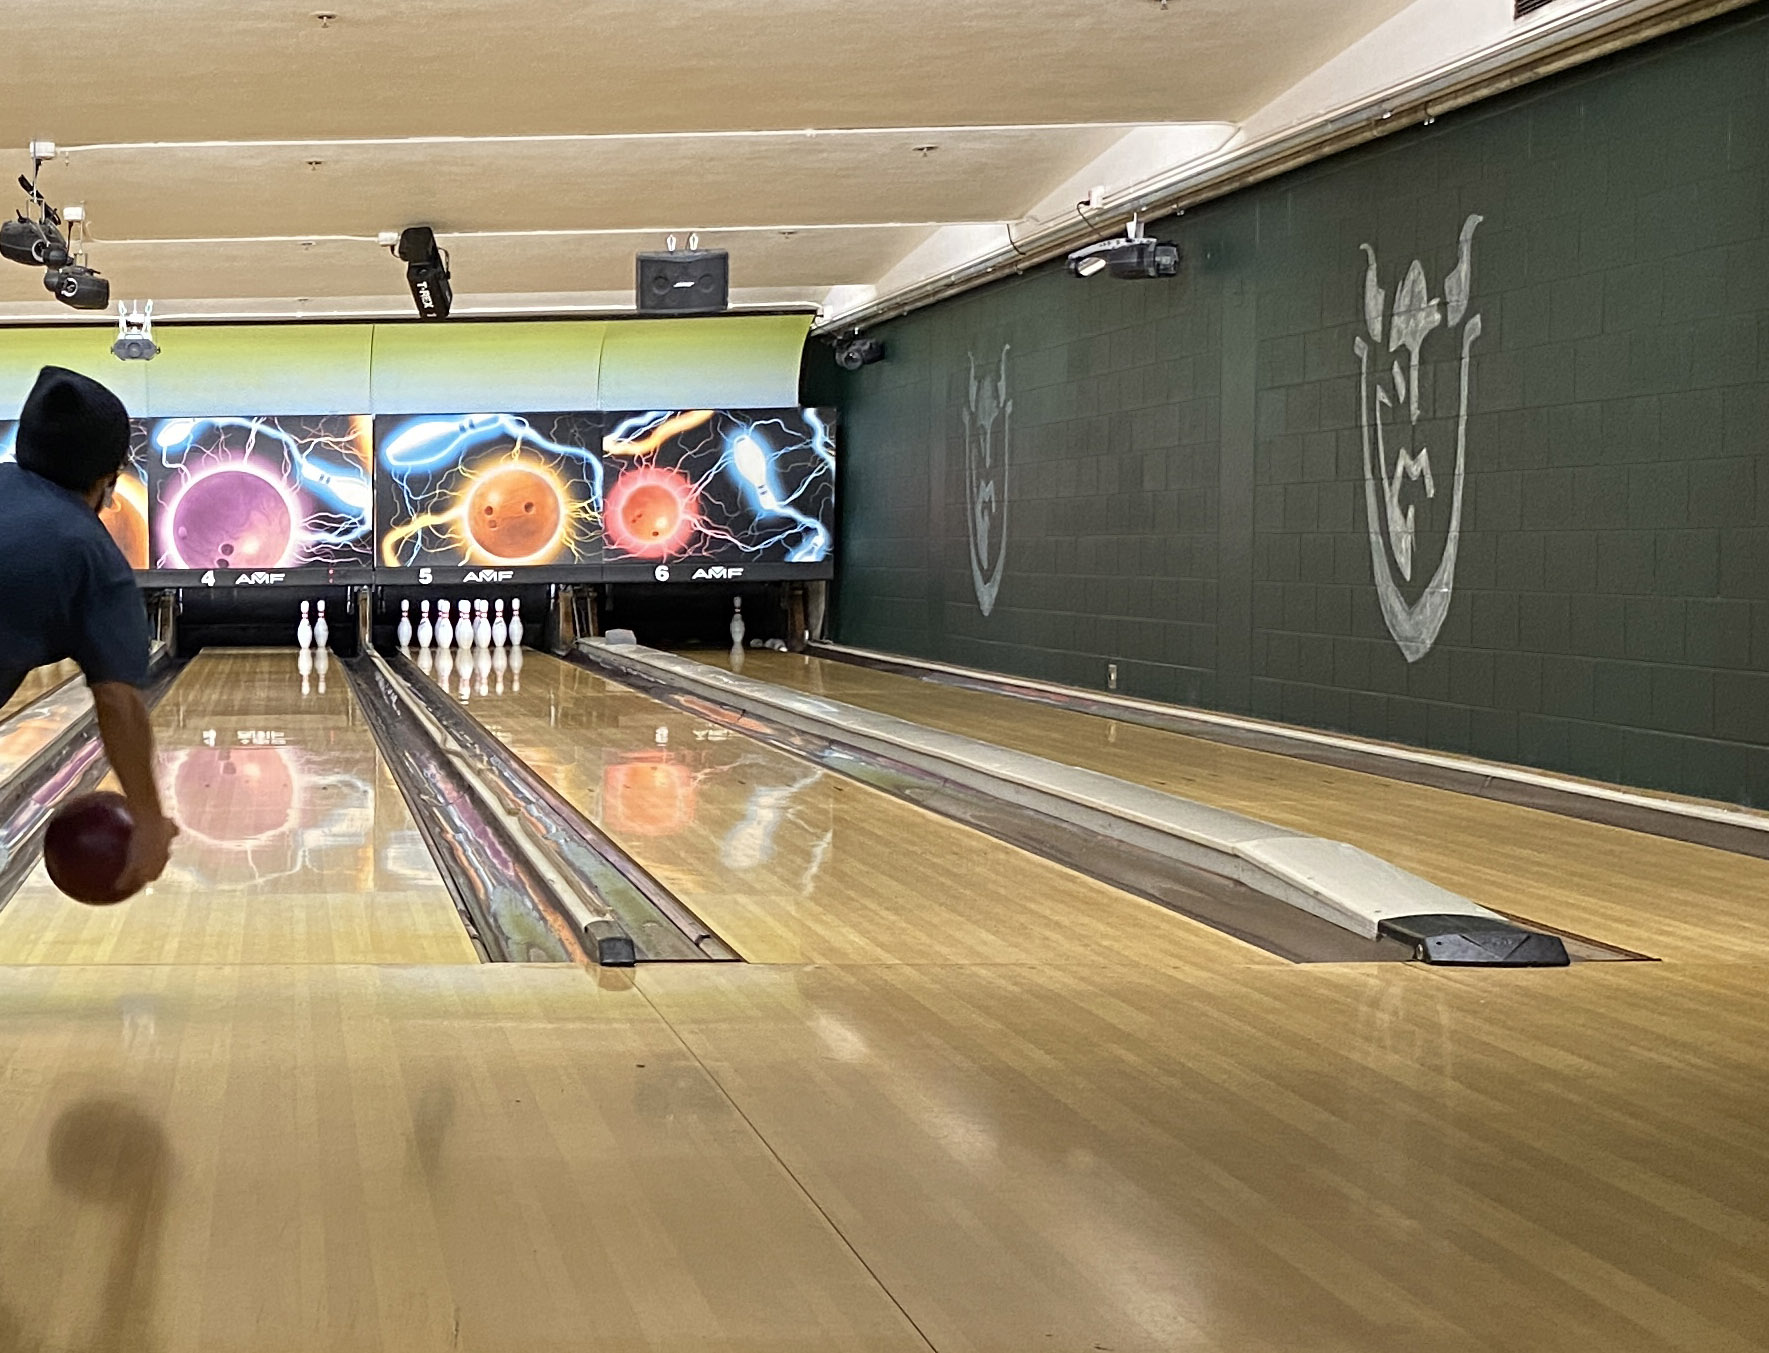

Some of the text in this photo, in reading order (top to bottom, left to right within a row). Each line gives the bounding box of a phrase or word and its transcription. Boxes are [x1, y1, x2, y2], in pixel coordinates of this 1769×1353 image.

[416, 281, 434, 309] T-REX
[200, 569, 285, 587] 4 AMF
[418, 567, 513, 585] 5 AMF
[654, 564, 744, 582] 6 AMF
